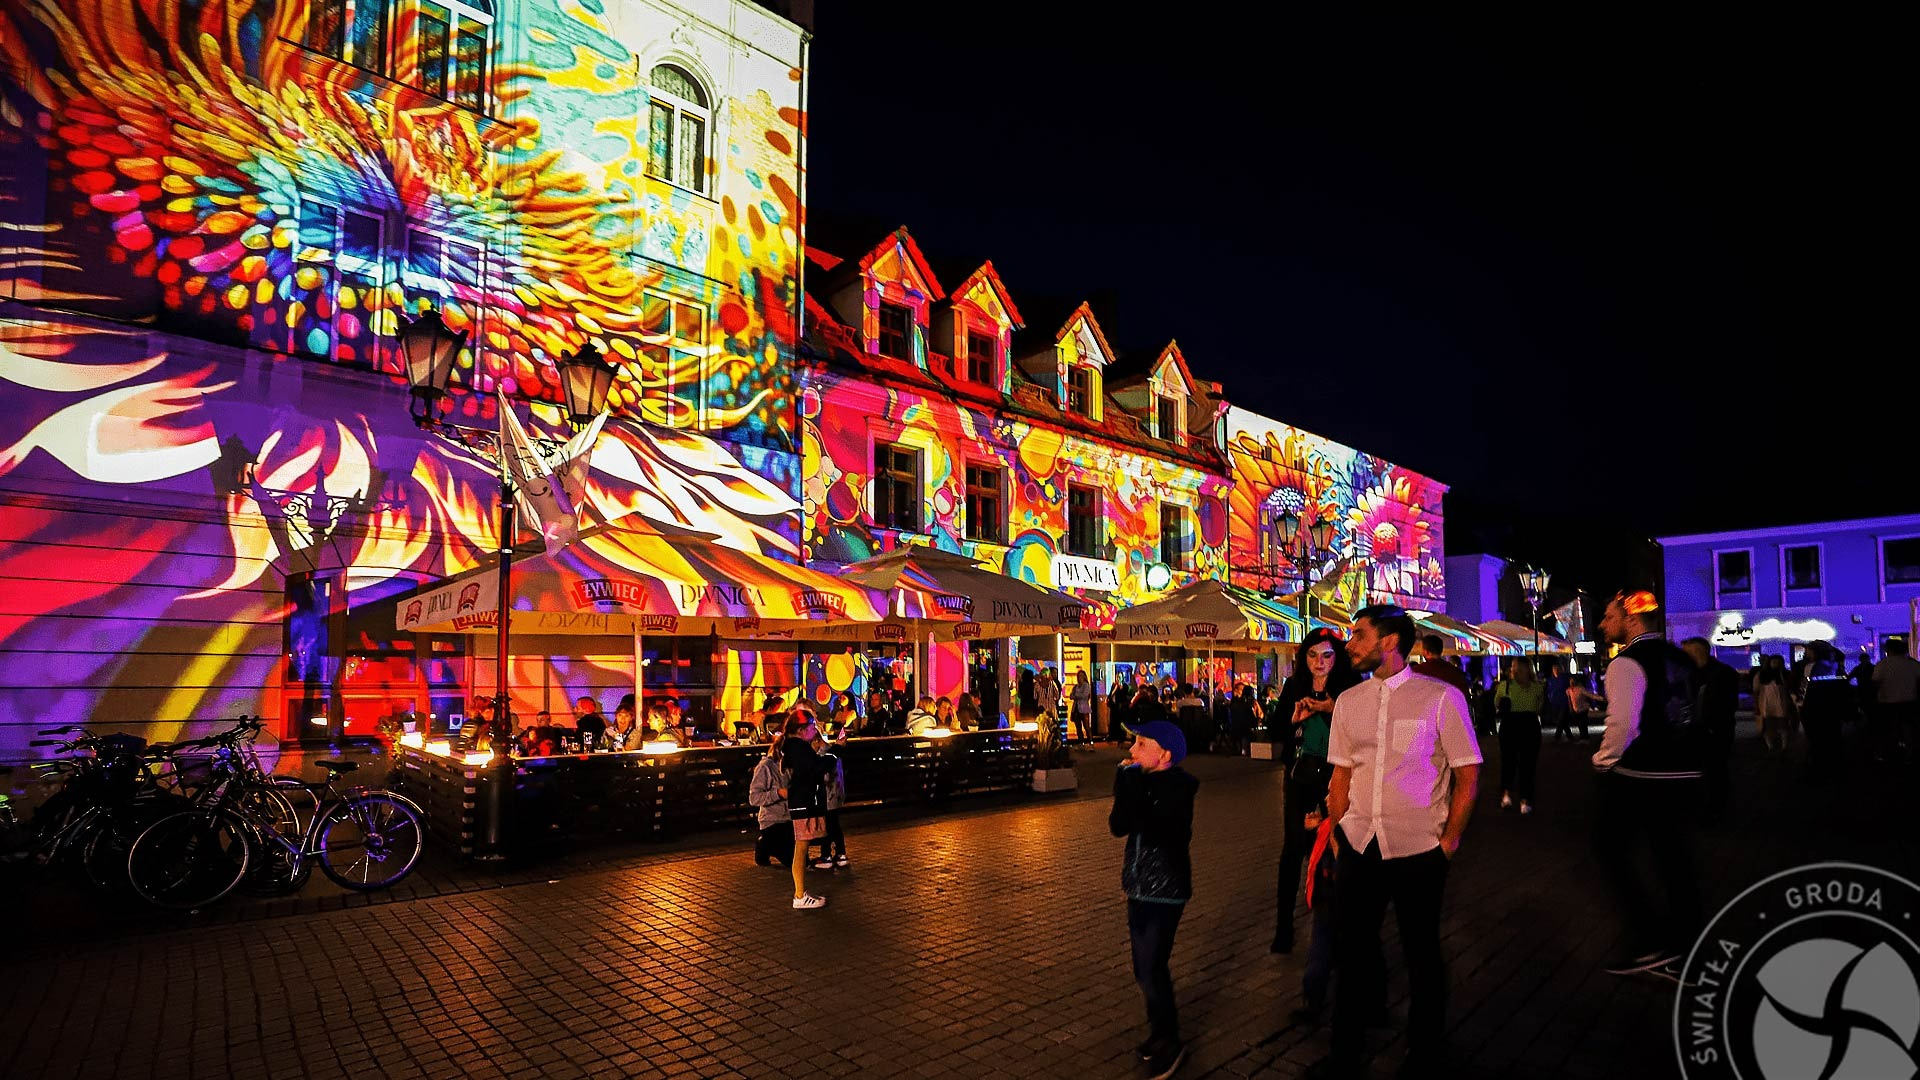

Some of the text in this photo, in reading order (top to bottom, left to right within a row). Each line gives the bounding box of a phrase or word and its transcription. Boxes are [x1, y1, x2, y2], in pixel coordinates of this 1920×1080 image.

[581, 580, 639, 601] ŻYWIEC
[680, 584, 766, 608] PIVNICA
[797, 592, 841, 609] ŻYWIEC
[992, 600, 1043, 620] PIVNICA
[1129, 623, 1171, 640] PIVNICA
